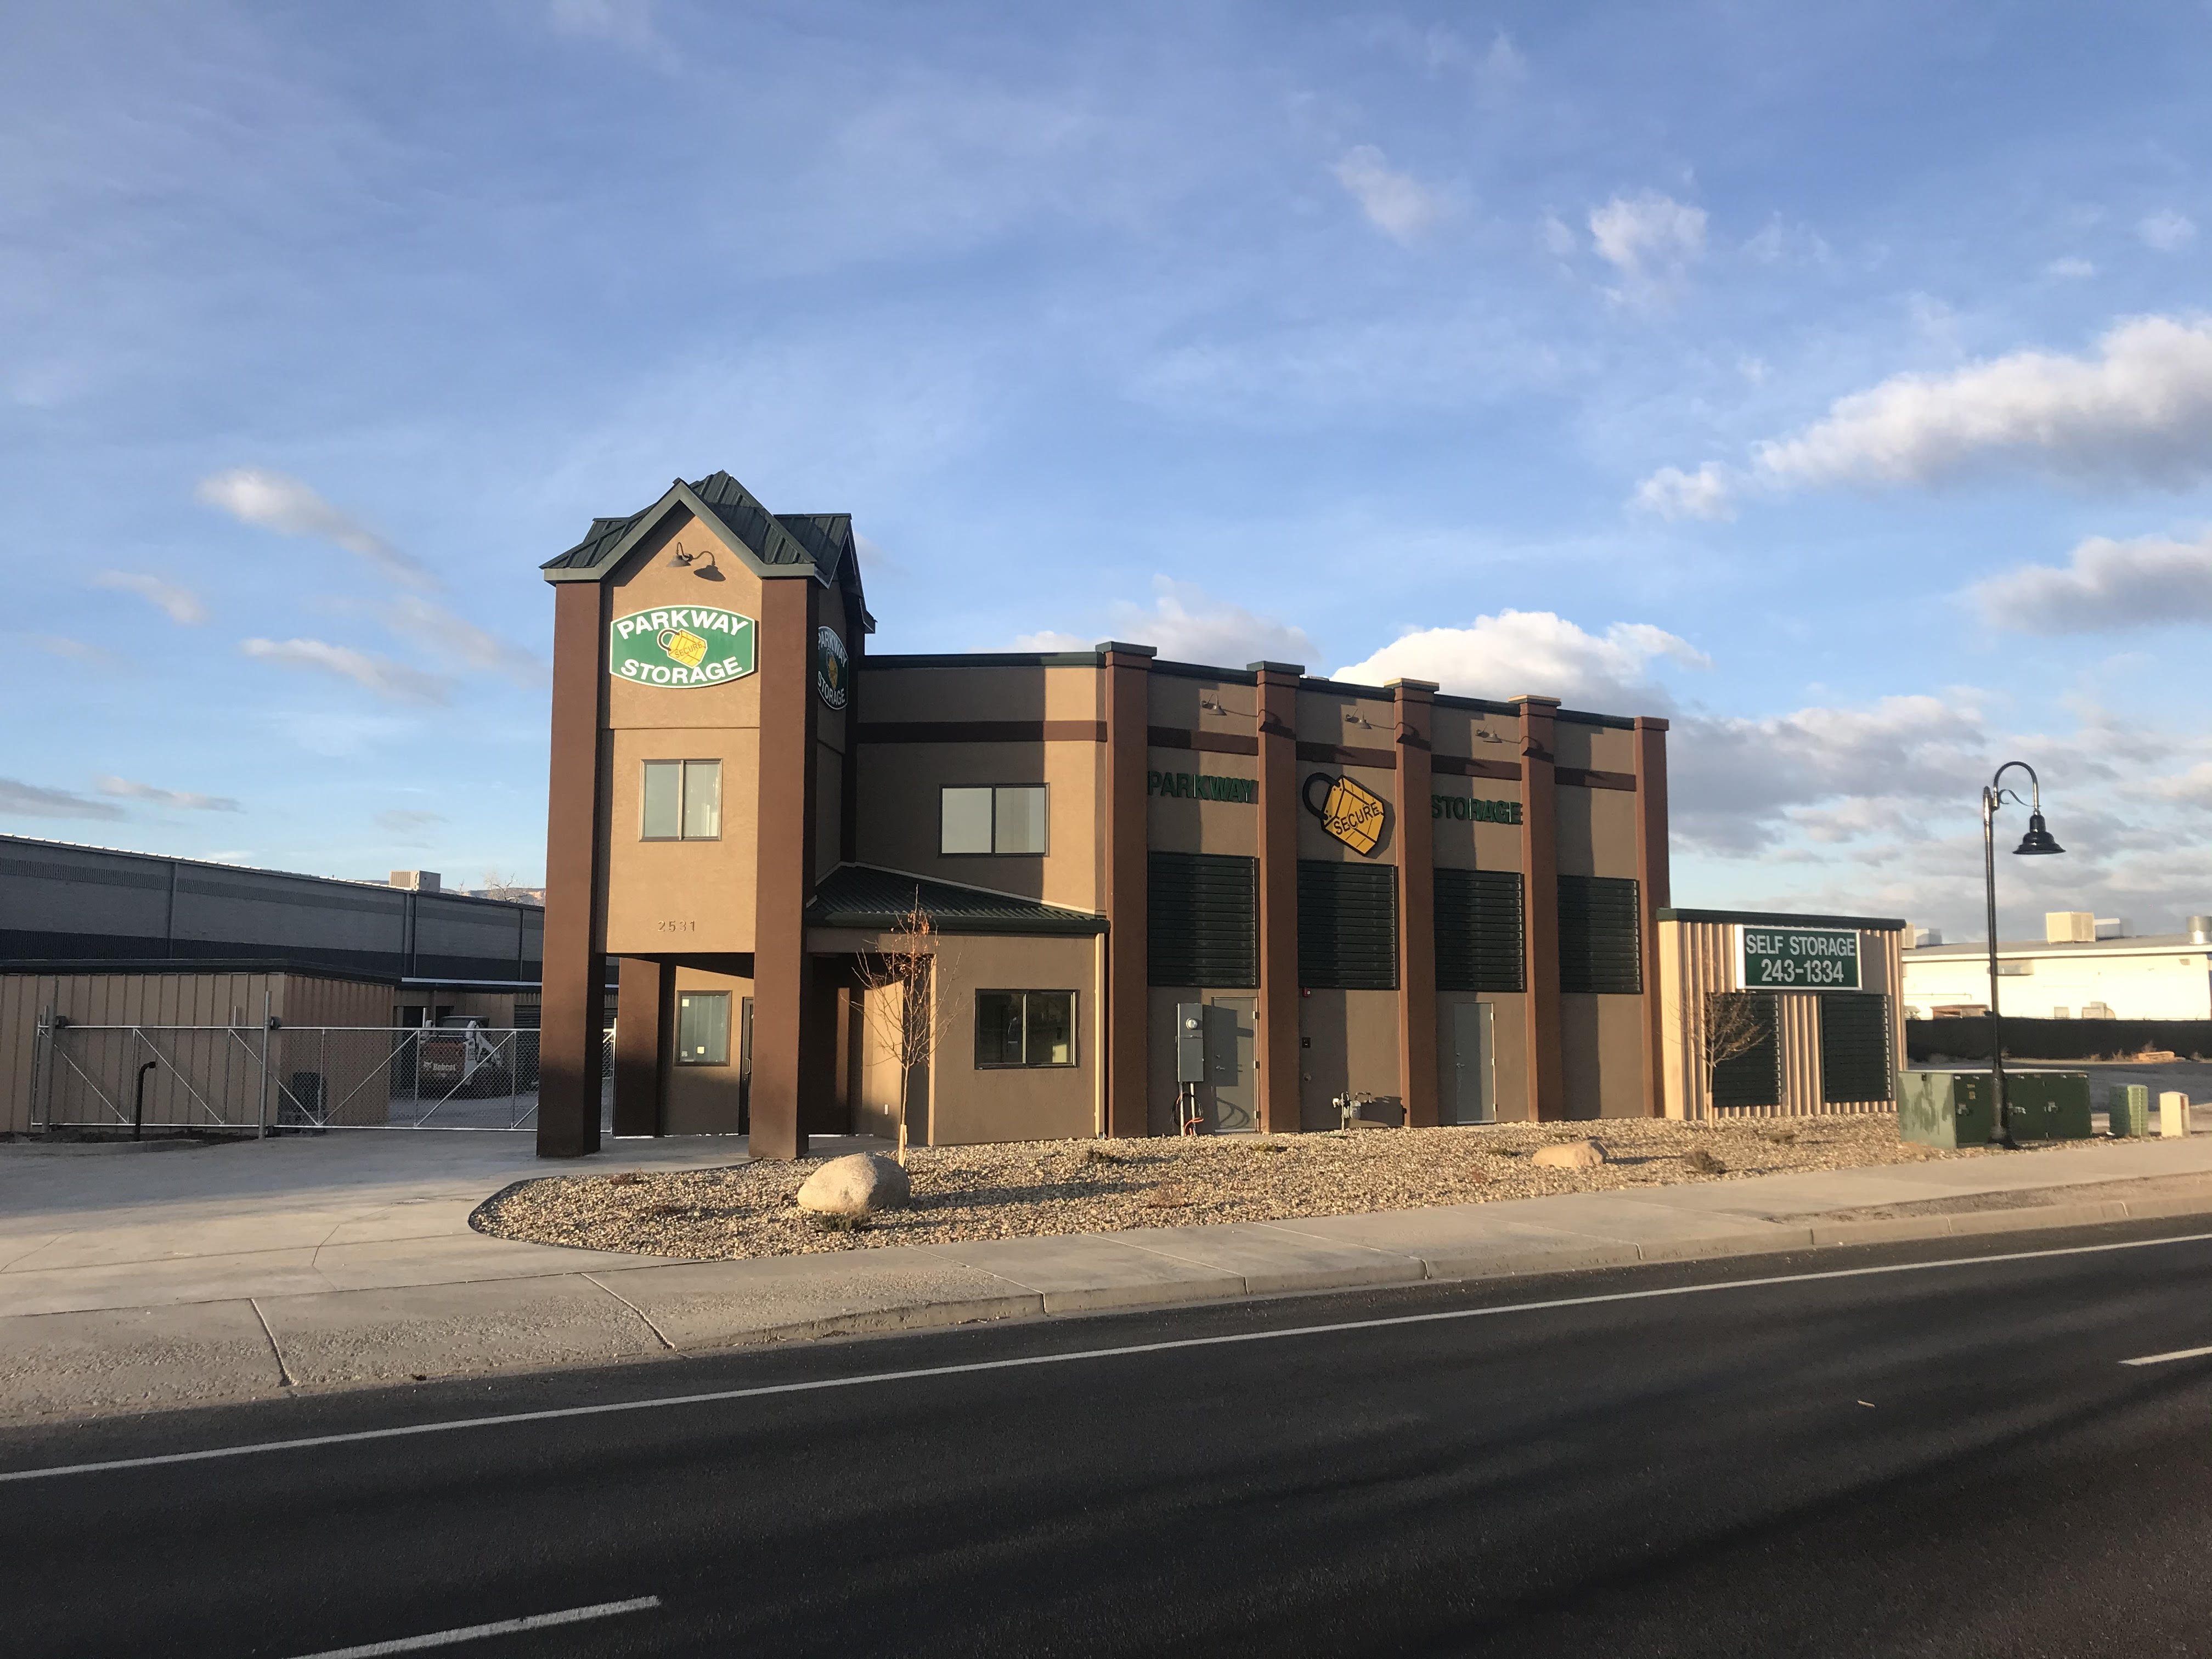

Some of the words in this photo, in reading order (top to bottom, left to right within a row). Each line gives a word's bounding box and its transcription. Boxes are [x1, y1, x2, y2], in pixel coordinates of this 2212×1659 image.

[617, 610, 749, 640] PARKWAY
[674, 641, 703, 658] SECURE
[620, 656, 743, 684] STORAGE
[818, 670, 845, 706] STORAGE
[1148, 770, 1256, 803] PARKWAY
[1431, 794, 1522, 825] STORAGE
[1334, 801, 1380, 835] SECURE
[658, 920, 695, 932] 2531
[1746, 934, 1784, 954] SELF
[1789, 936, 1856, 956] STORAGE
[1760, 958, 1844, 983] 243-1334
[433, 1063, 456, 1071] Bobcat
